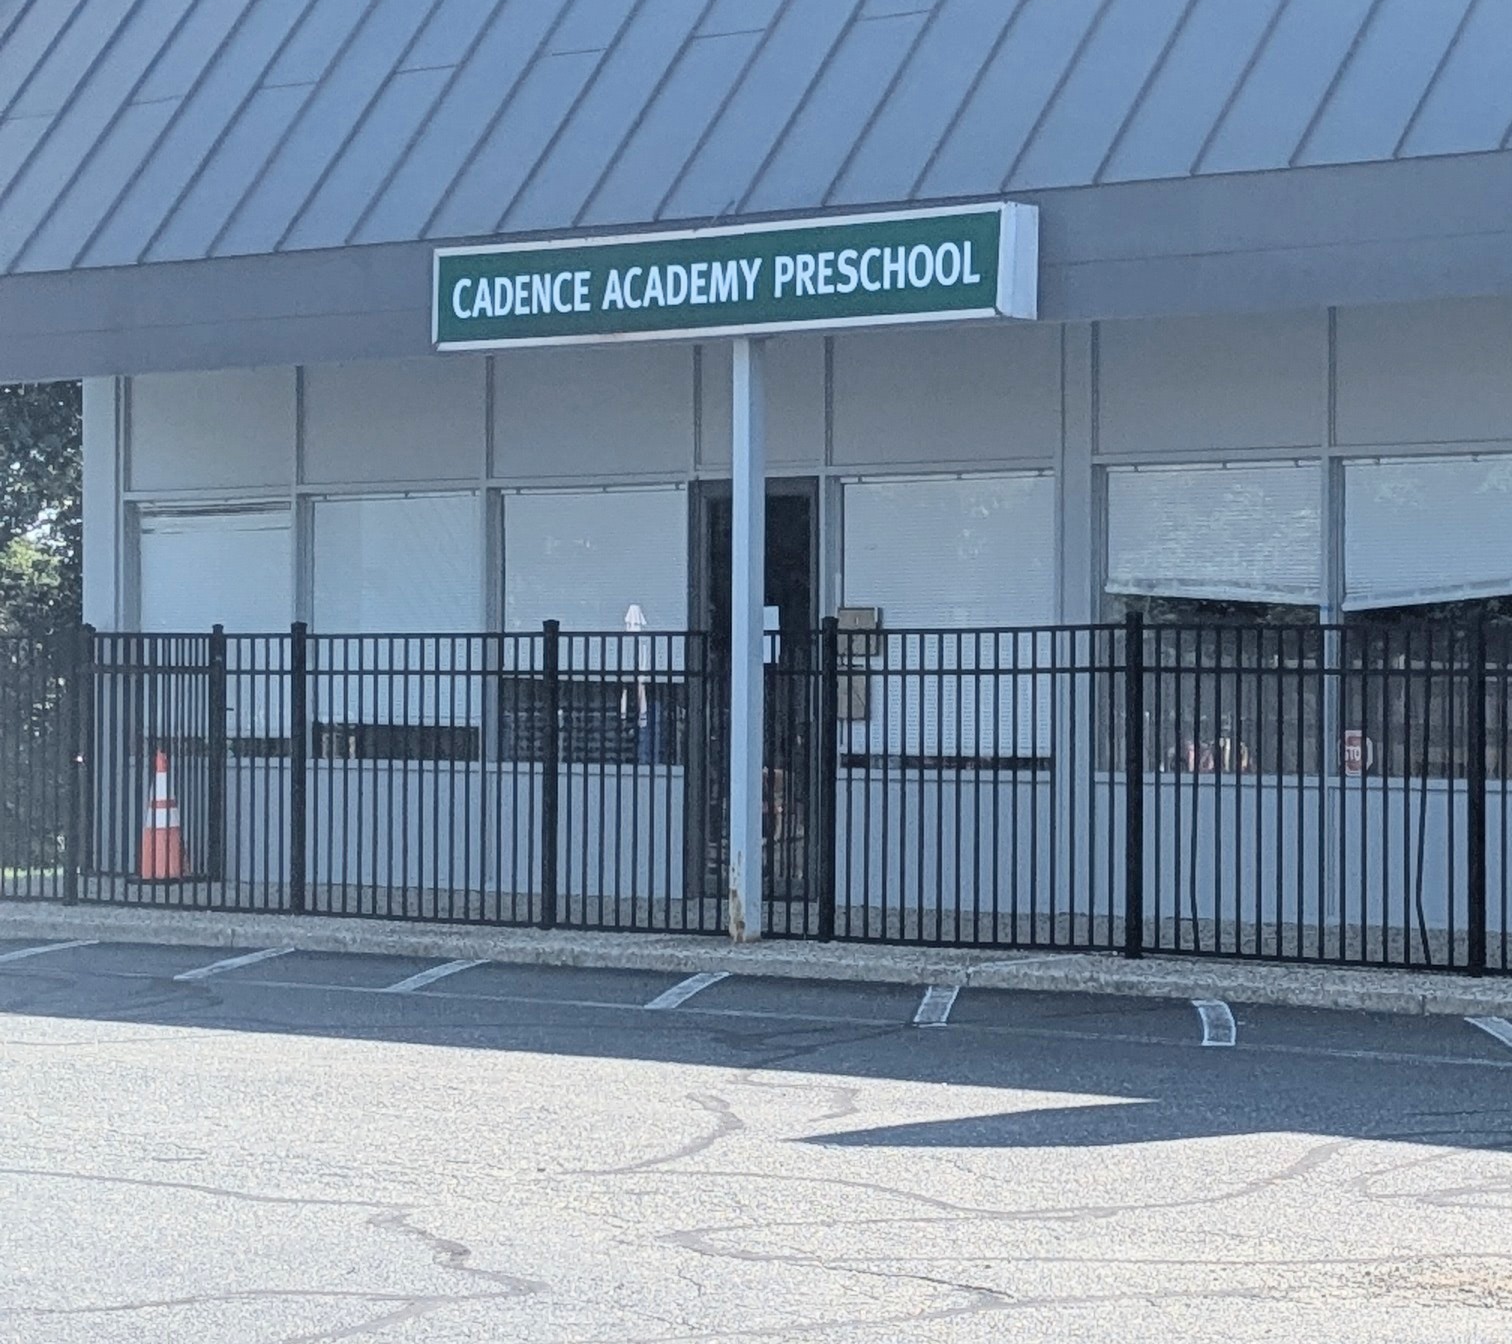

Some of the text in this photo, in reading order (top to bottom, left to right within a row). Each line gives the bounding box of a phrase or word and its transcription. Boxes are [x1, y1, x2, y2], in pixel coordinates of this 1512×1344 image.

[452, 240, 981, 319] CADENCE ACADEMY PRESCHOOL
